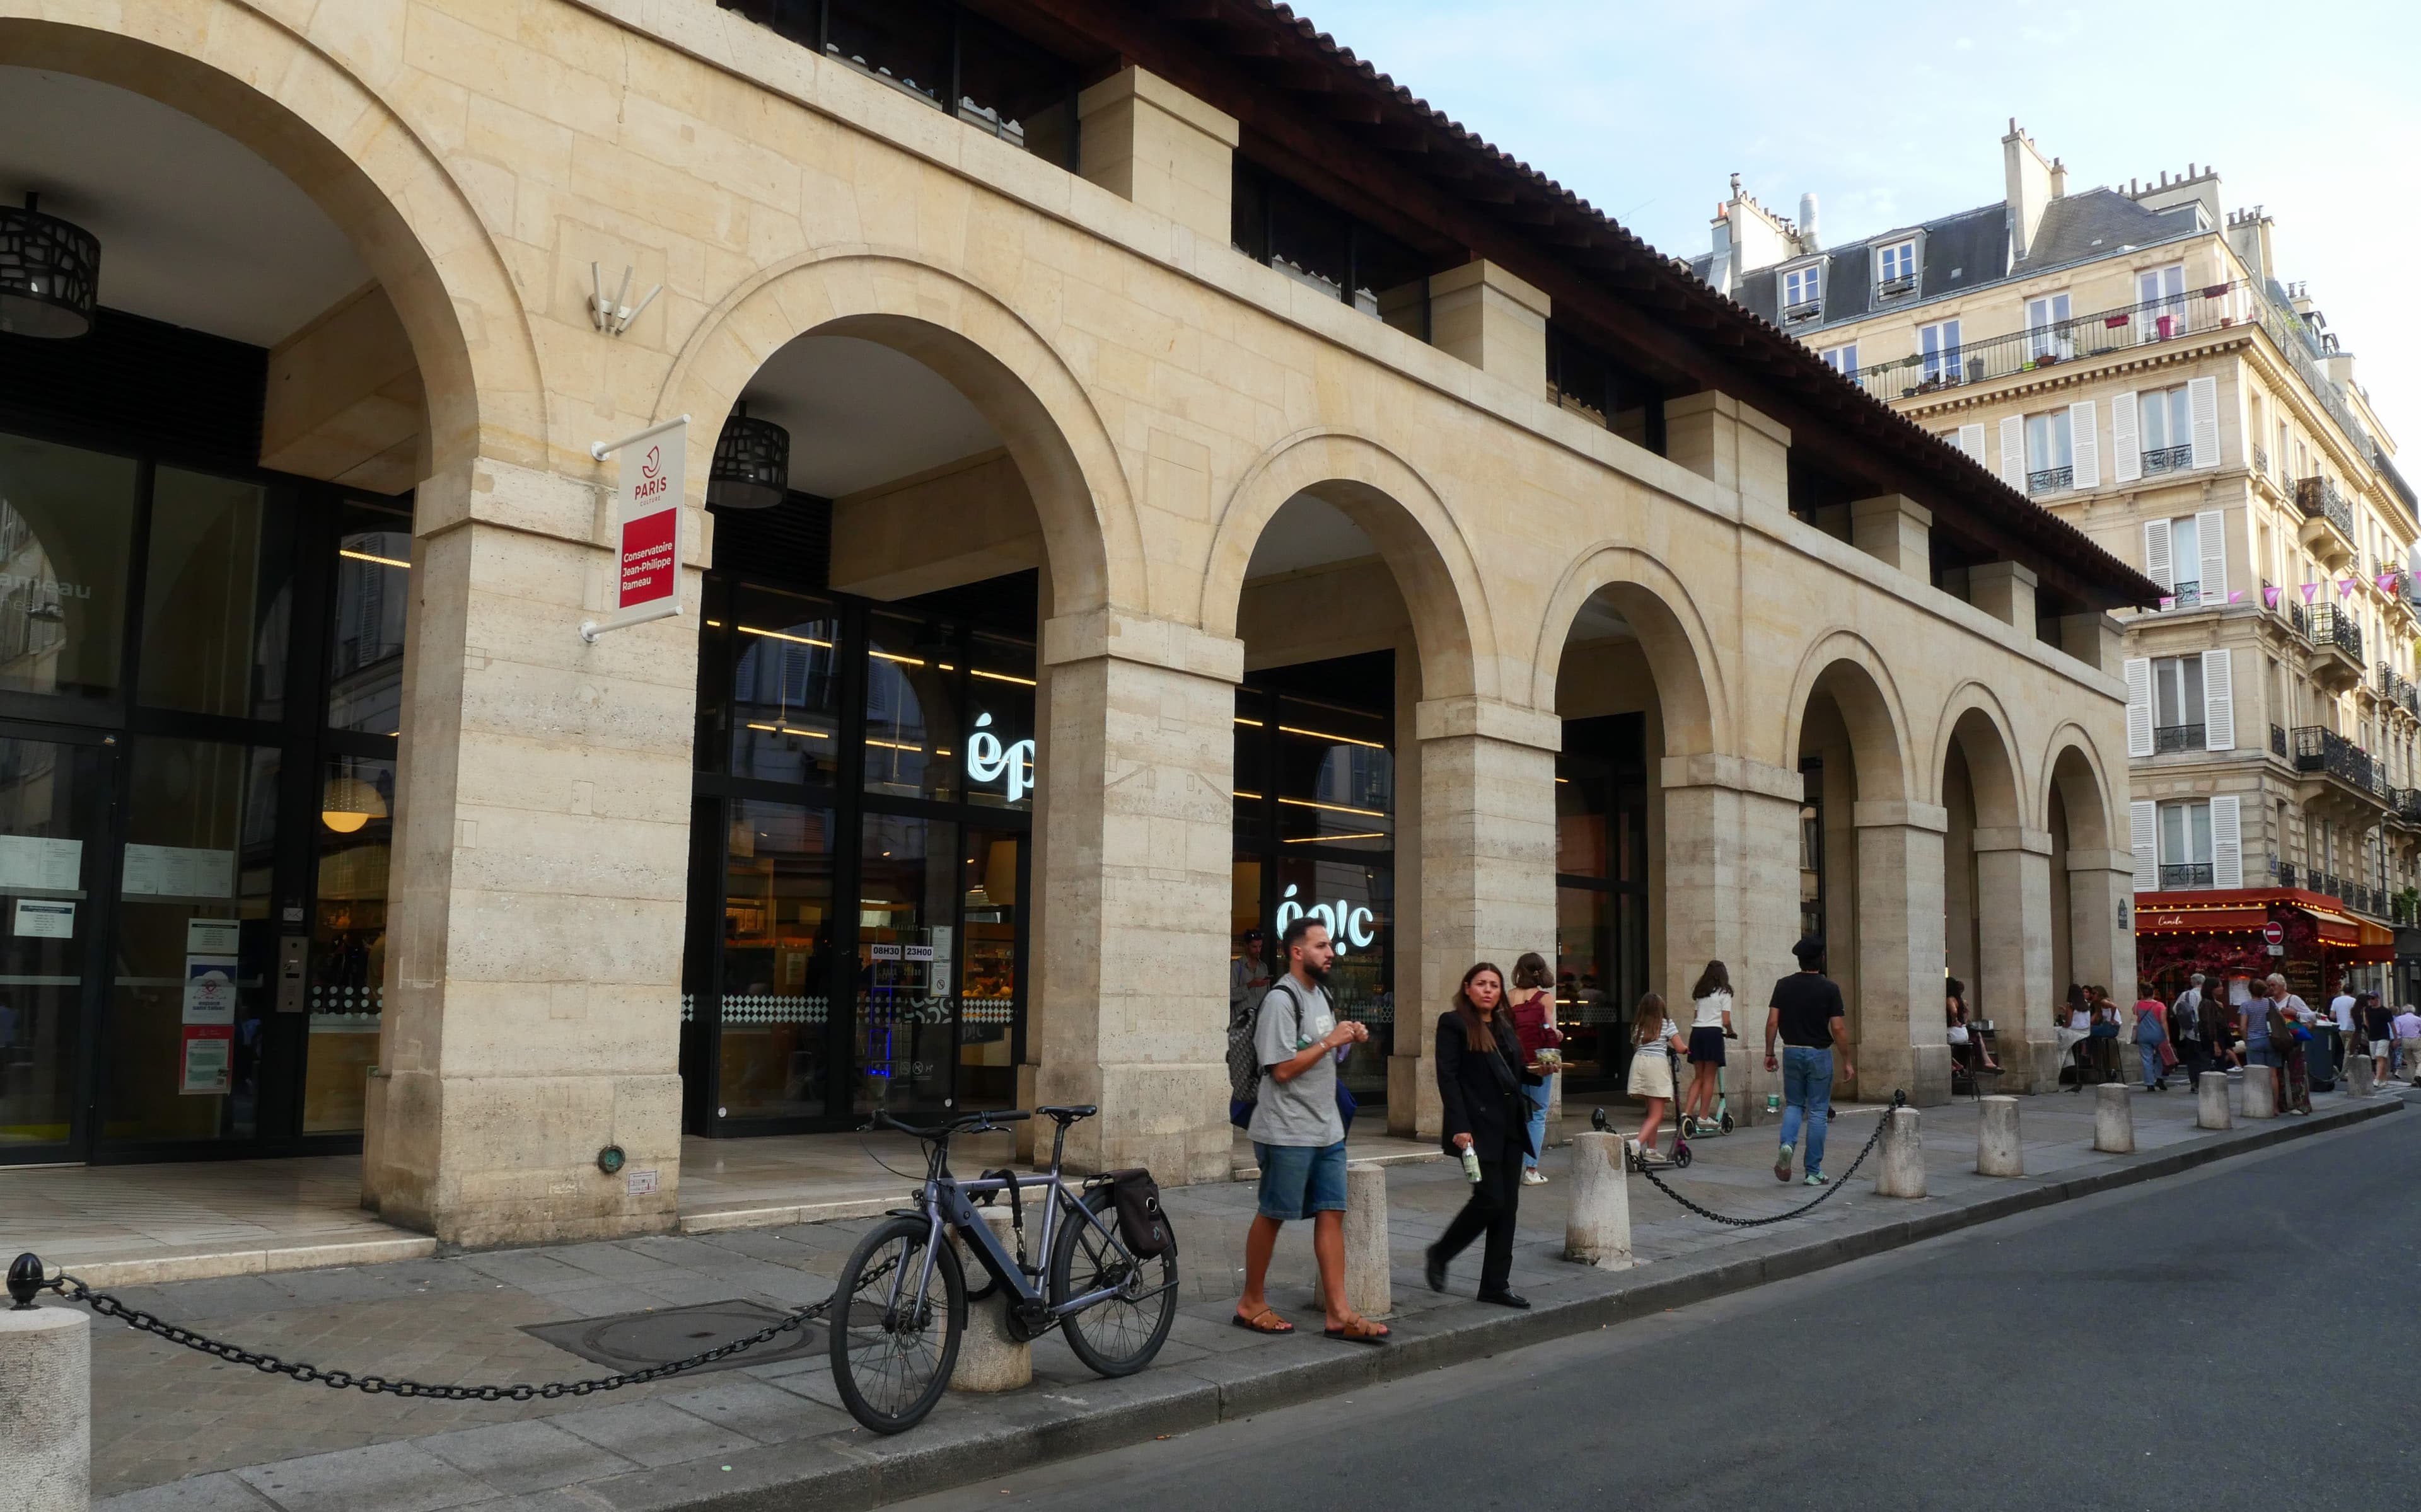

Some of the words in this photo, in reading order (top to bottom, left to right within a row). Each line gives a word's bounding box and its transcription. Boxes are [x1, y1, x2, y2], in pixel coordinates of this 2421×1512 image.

[635, 476, 666, 500] PARIS
[640, 495, 661, 507] CULTURE
[624, 541, 673, 563] Conservatoire
[622, 557, 671, 577] Jean-Philippe
[622, 577, 651, 591] Rameau
[873, 947, 900, 955] 08H30
[907, 947, 932, 956] 23H00
